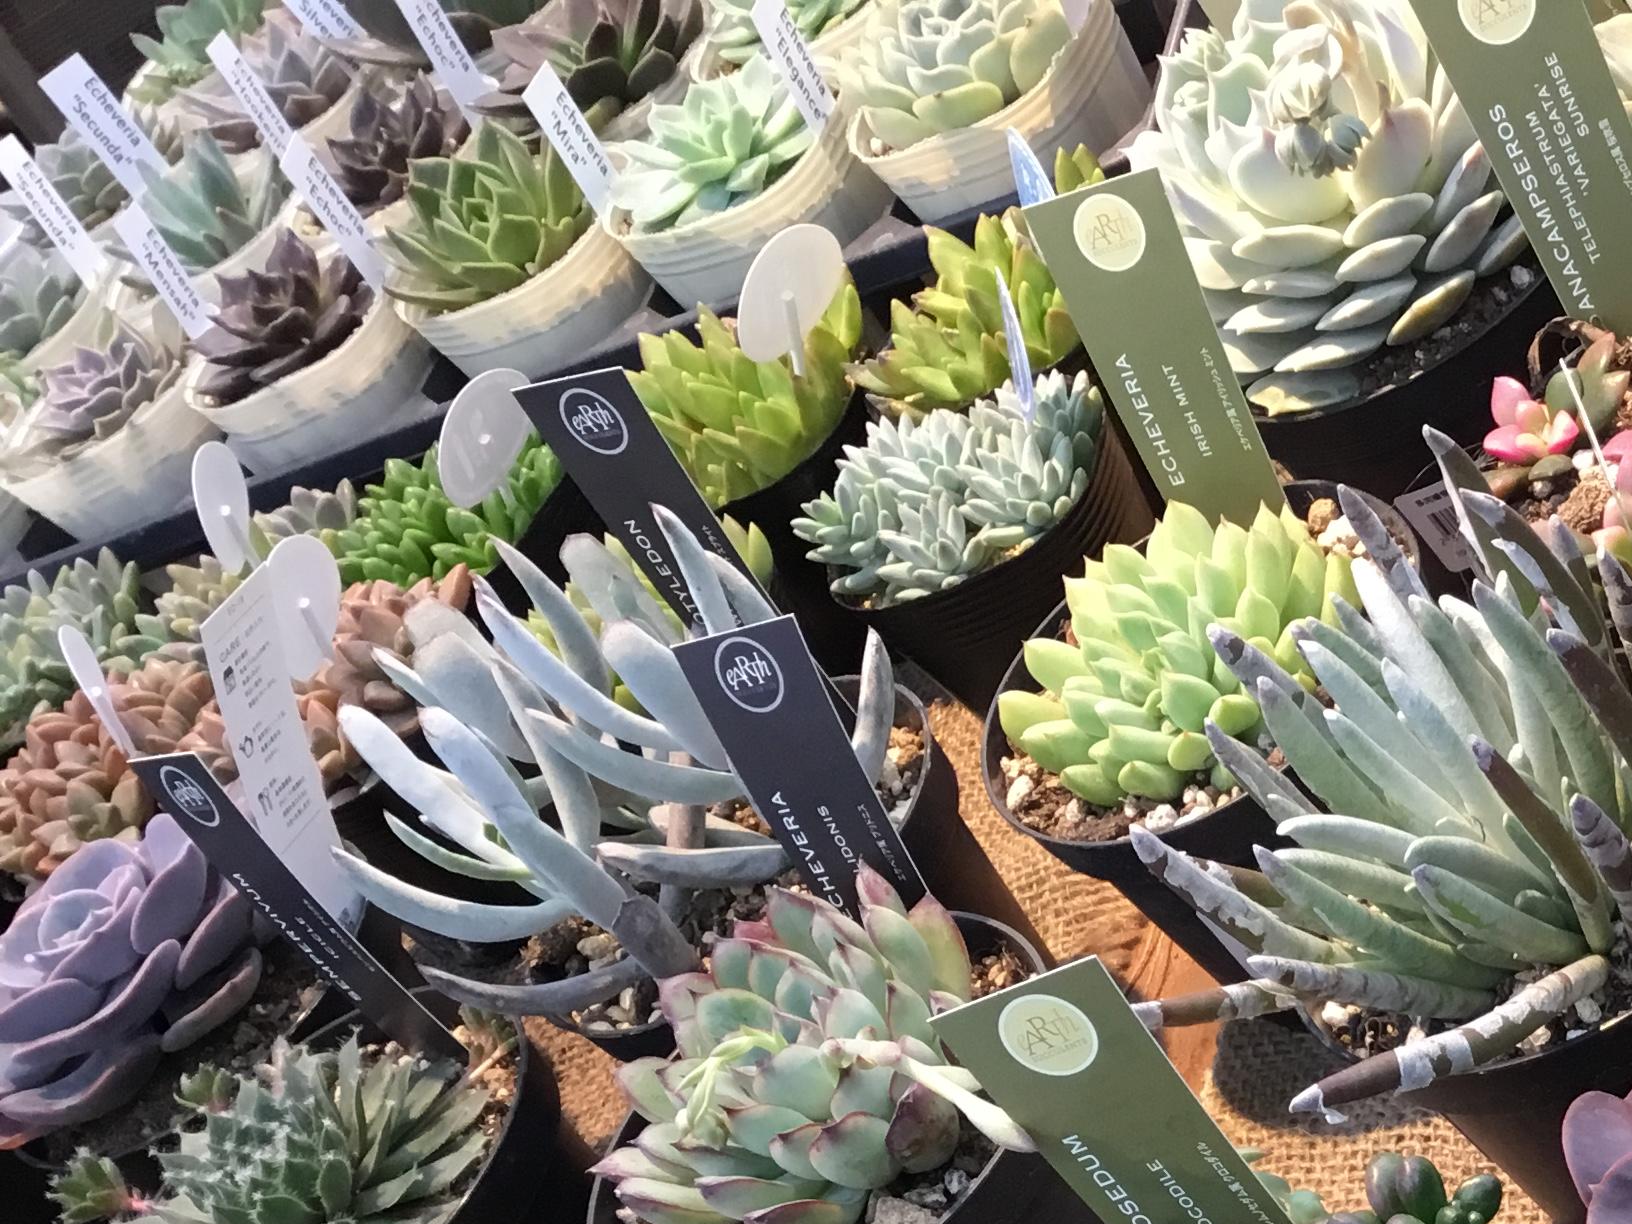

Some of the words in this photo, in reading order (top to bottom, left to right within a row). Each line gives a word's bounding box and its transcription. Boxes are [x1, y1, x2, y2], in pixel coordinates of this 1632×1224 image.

[424, 0, 471, 72] cheveria
[779, 7, 826, 97] Echeveria
[83, 76, 142, 147] Echeveria
[233, 56, 286, 135] Echeveria
[555, 91, 609, 176] Echeveria
[1545, 52, 1589, 138] SUNRISE
[22, 161, 77, 236] Echeveria
[307, 157, 365, 236] Echeveria
[1489, 104, 1596, 309] ANACAMPSEROS
[1525, 111, 1600, 265] TELEPHIASTRUM
[145, 228, 200, 308] Echeveria
[1116, 353, 1185, 487] ECHEVERIA
[1162, 364, 1189, 407] MINT
[1185, 411, 1213, 457] IRISH
[624, 519, 705, 625] OTYLEDON
[232, 872, 362, 1002] SEMPERVIVUM
